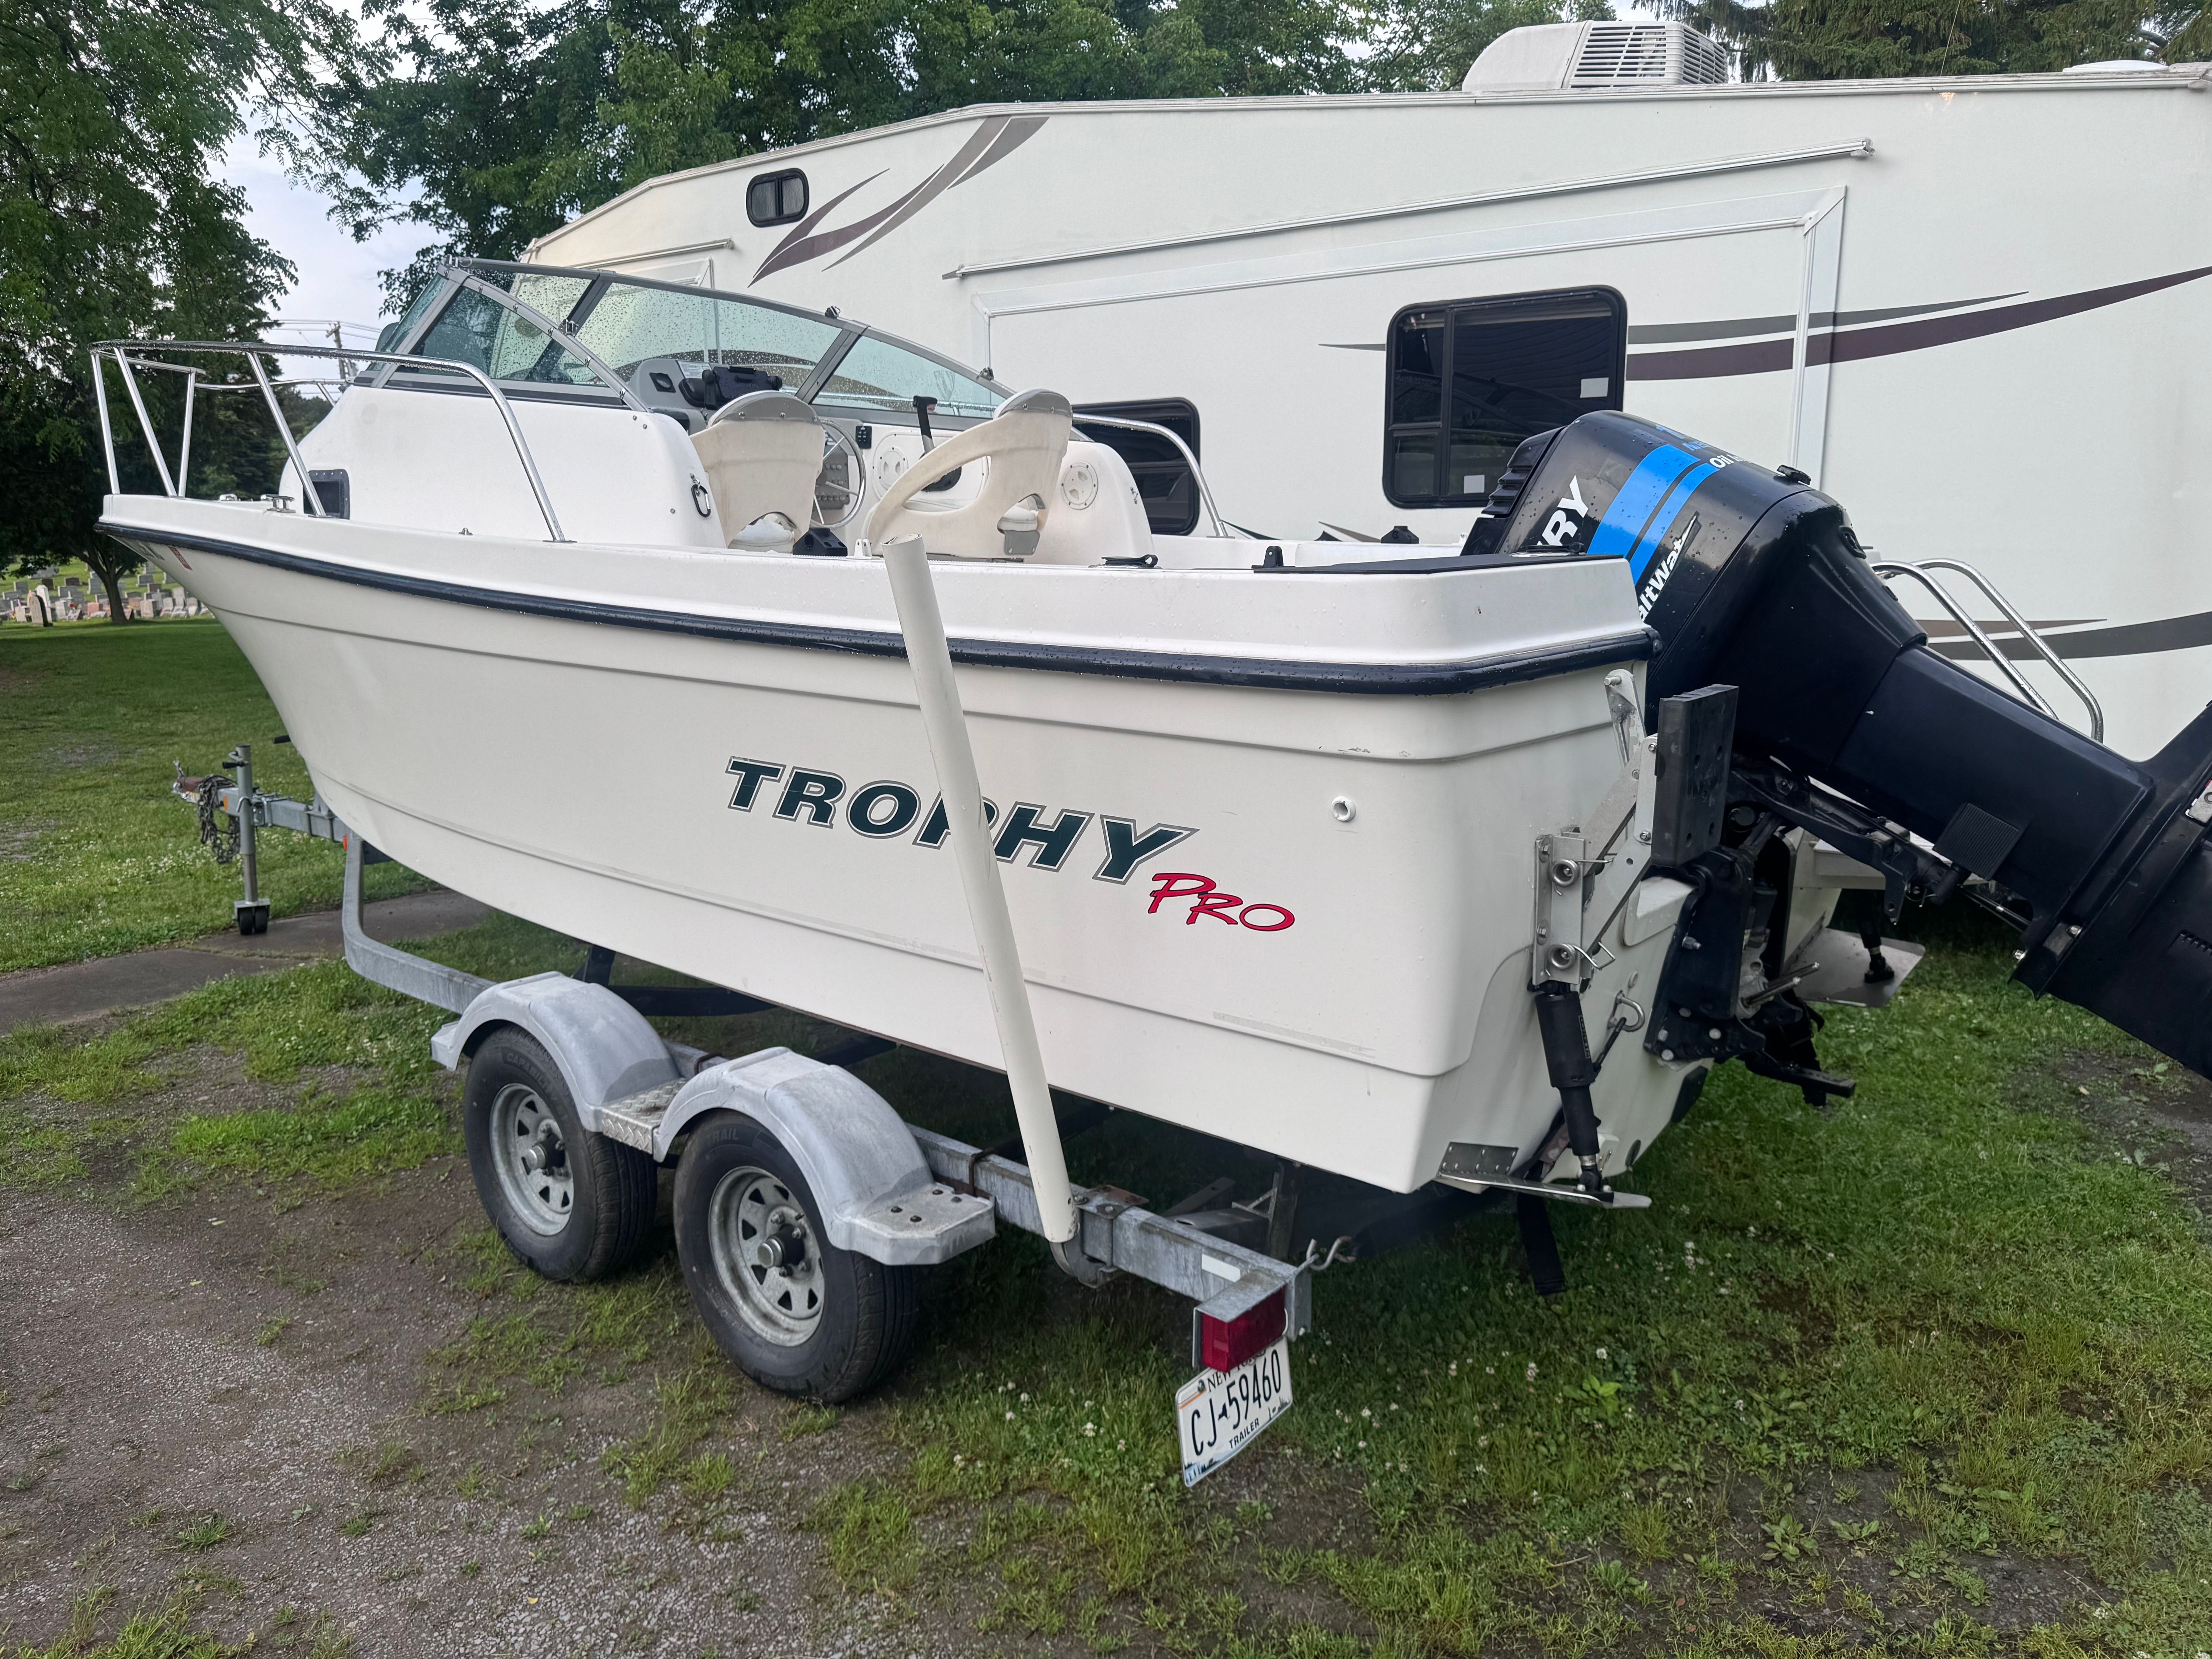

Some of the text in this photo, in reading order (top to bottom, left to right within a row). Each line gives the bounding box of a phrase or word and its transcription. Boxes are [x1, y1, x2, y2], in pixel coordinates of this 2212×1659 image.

[1709, 455, 1734, 468] Oil
[1537, 475, 1589, 546] RY
[1148, 872, 1295, 931] PRO
[1229, 1417, 1260, 1449] TRAILER
